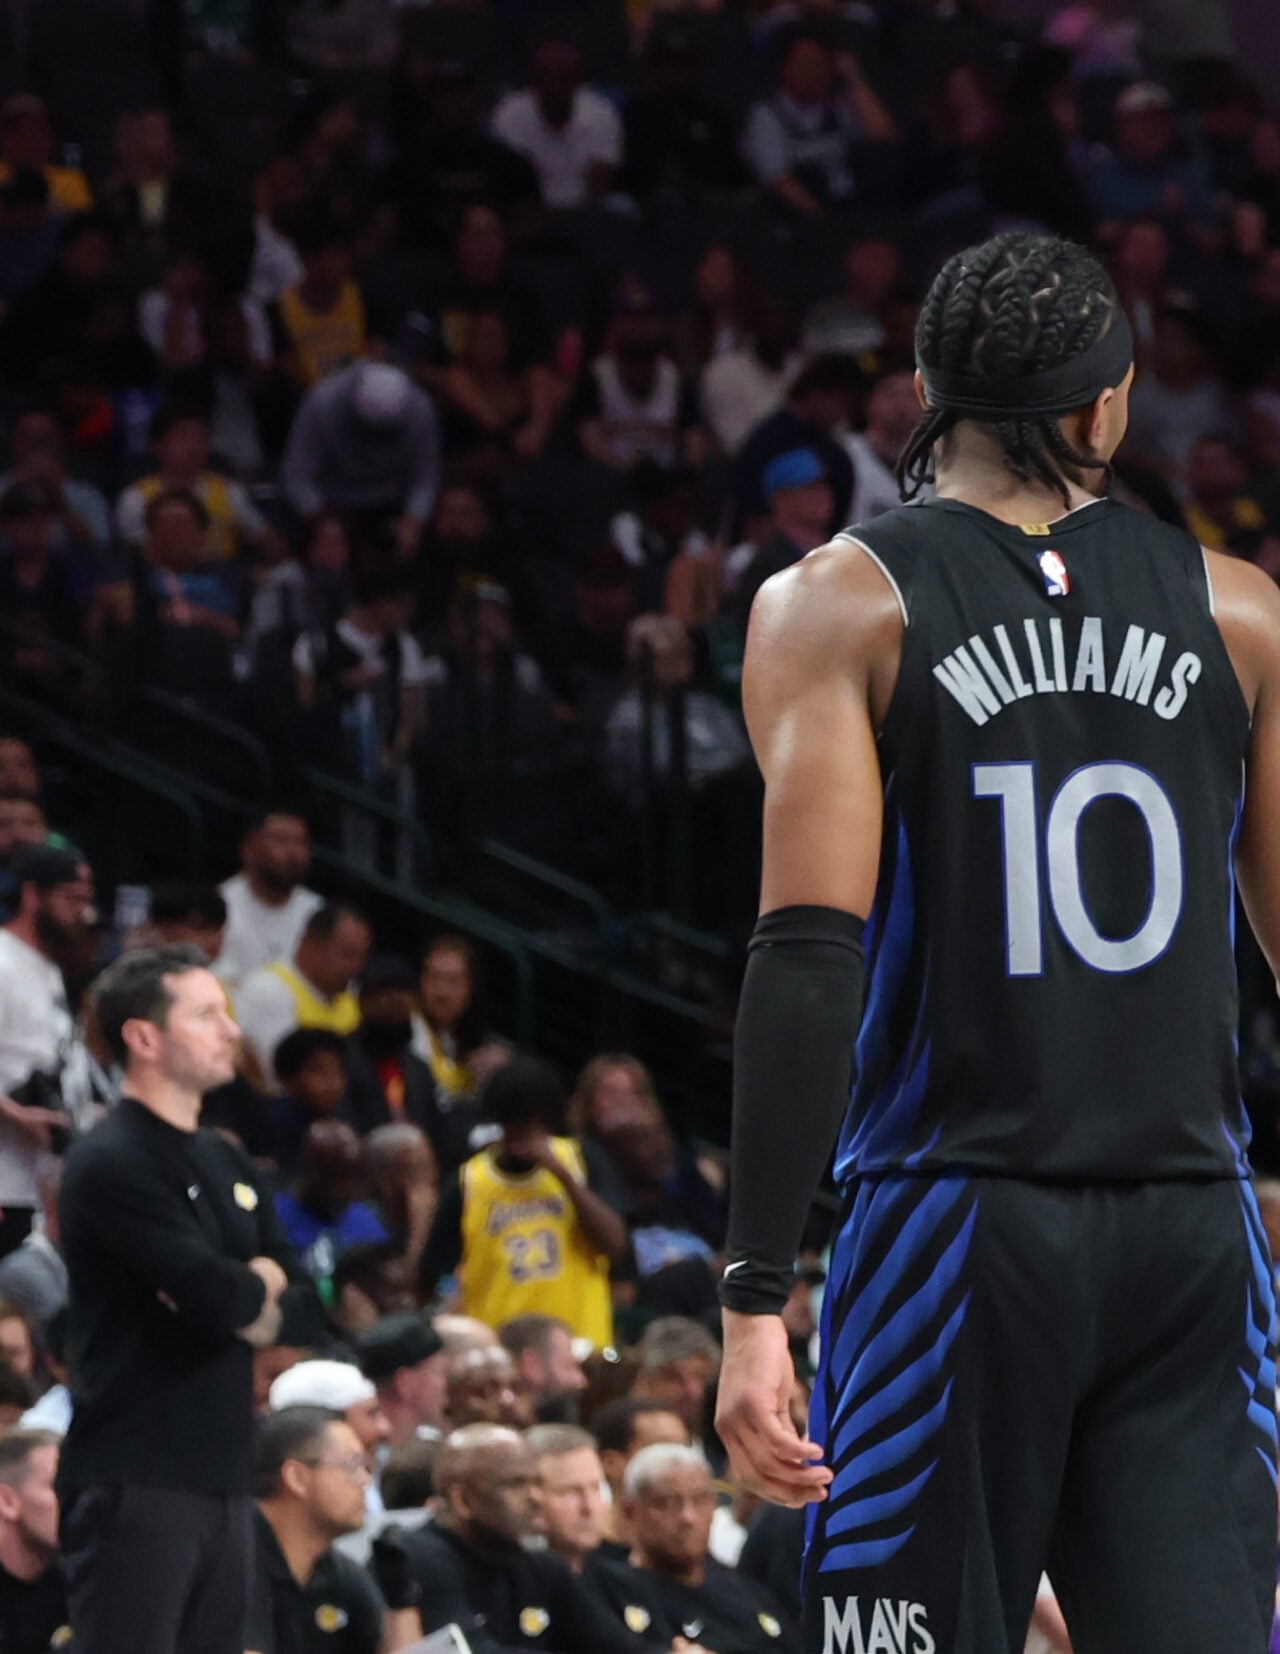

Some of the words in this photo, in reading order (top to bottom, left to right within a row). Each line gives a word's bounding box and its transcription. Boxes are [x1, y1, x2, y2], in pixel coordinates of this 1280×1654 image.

[932, 617, 1203, 727] WILLIAMS
[971, 759, 1185, 978] 10
[503, 1228, 562, 1284] 23
[821, 1595, 937, 1654] MAVS
